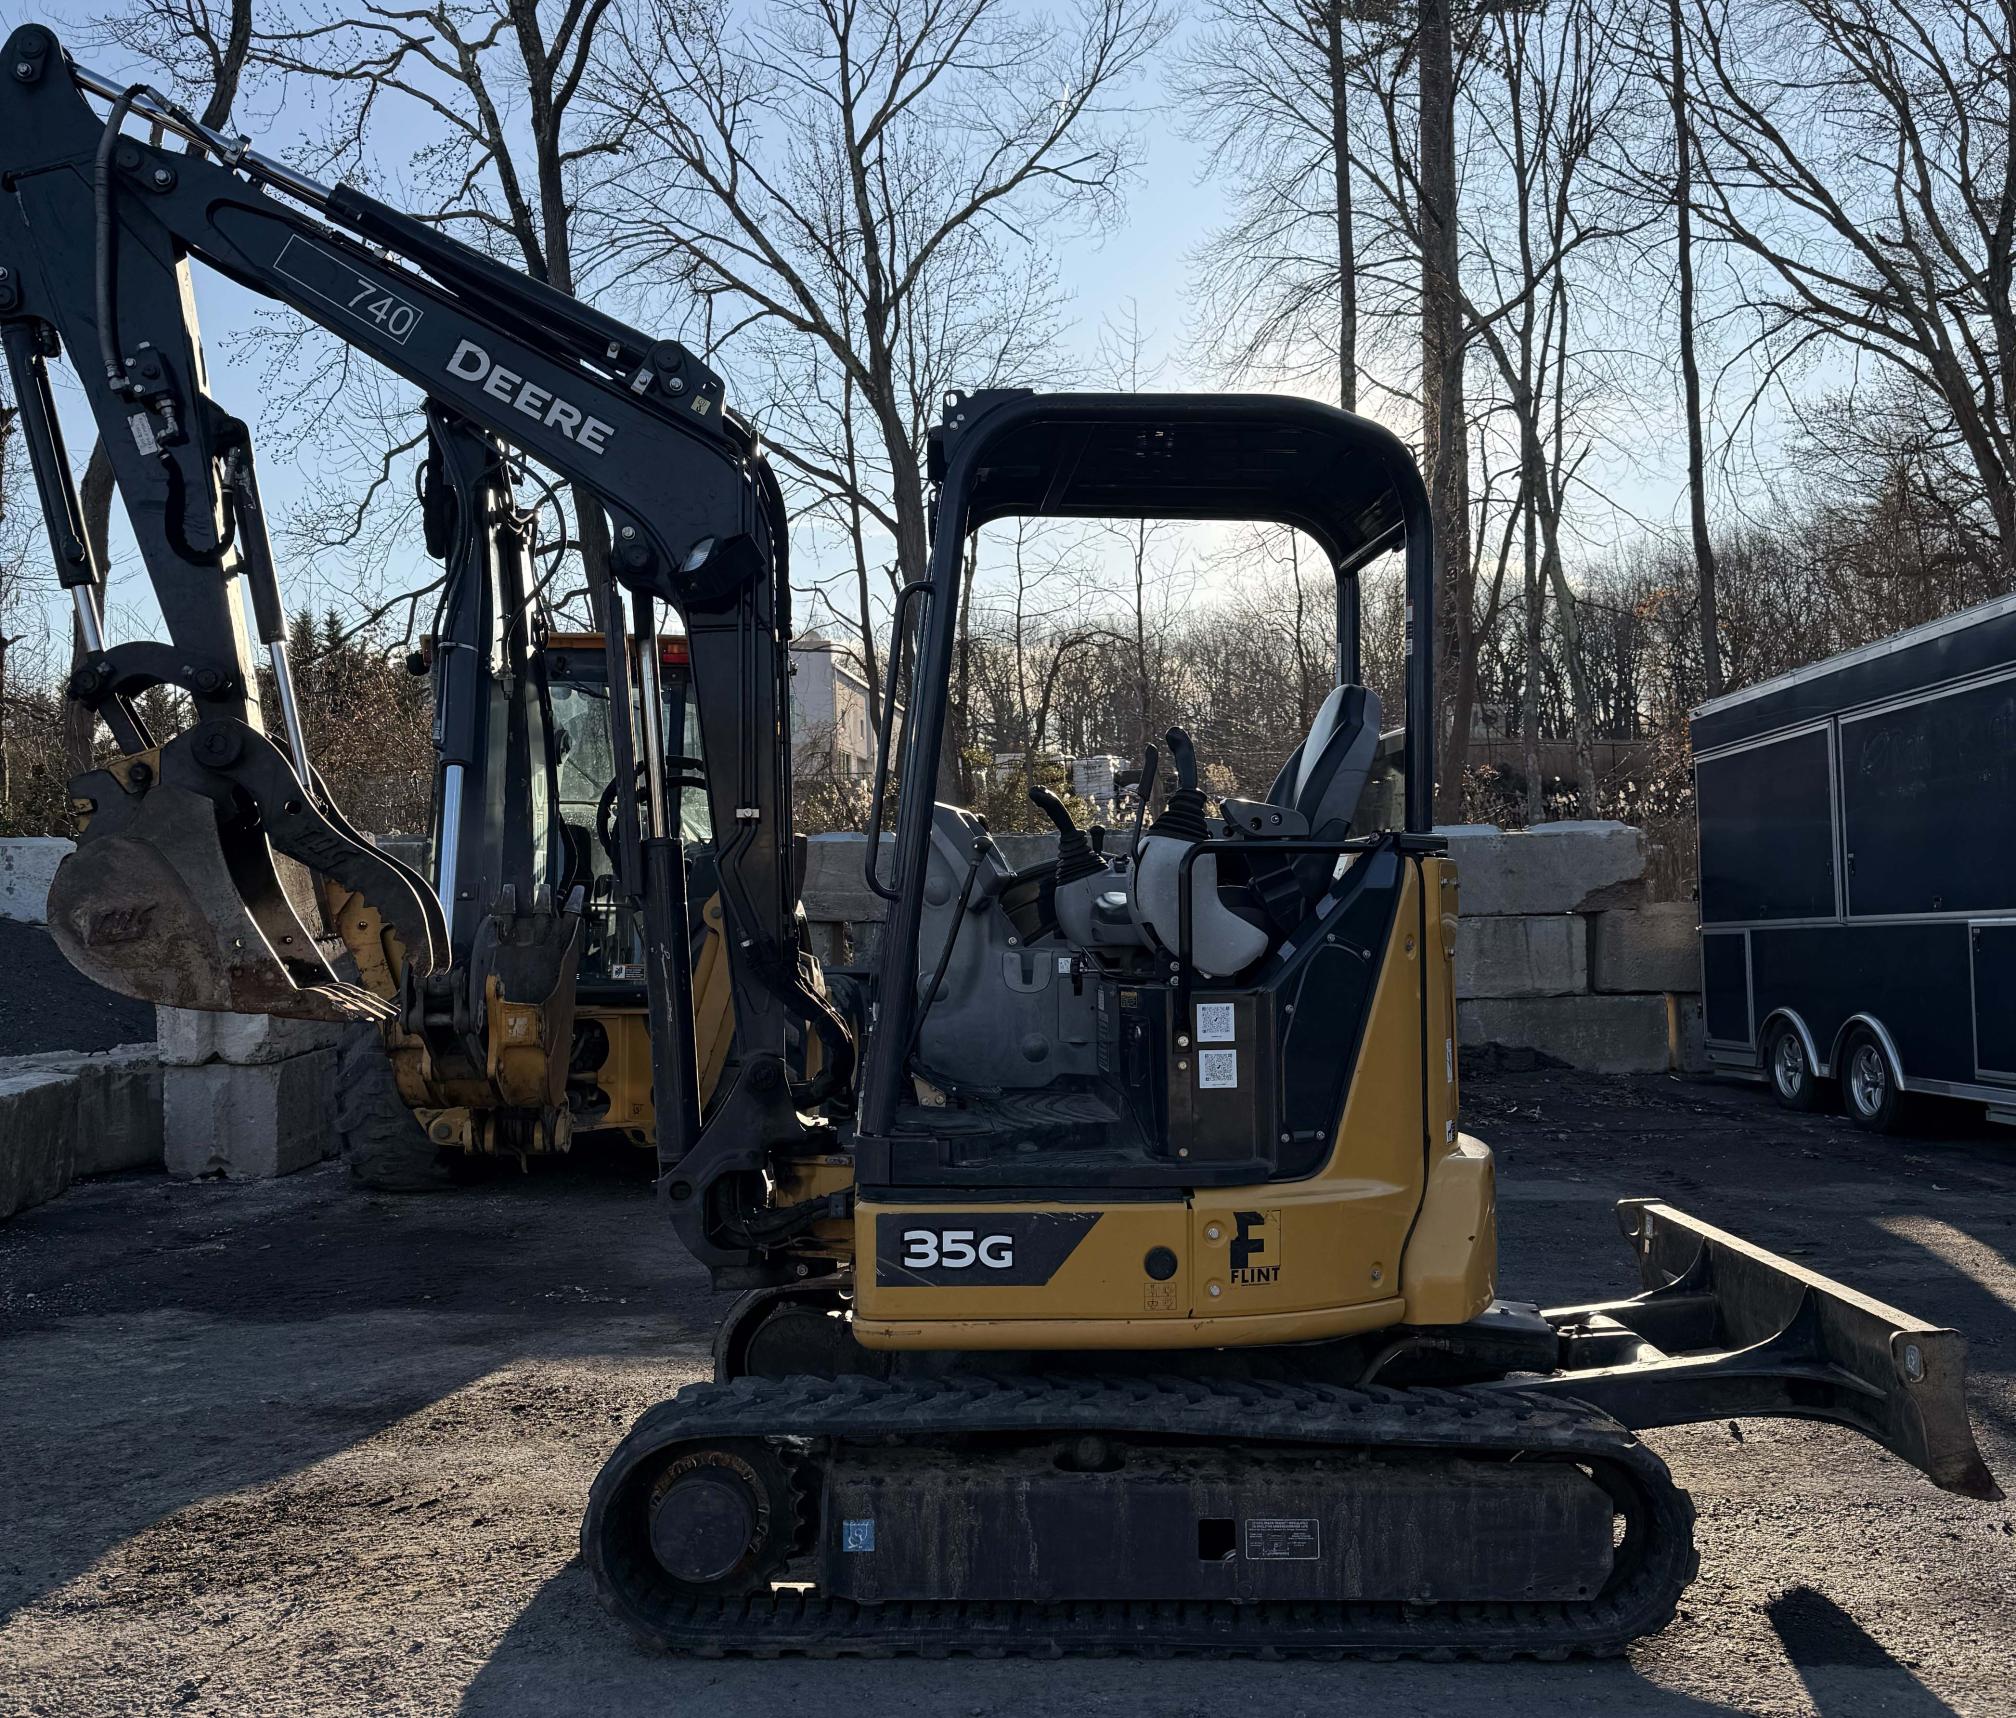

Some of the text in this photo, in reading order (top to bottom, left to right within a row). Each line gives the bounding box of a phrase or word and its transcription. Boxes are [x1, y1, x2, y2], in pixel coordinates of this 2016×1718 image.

[347, 279, 414, 336] 740
[445, 339, 615, 455] DEERE
[903, 1229, 1013, 1269] 35G
[1231, 1267, 1280, 1284] FLINT
